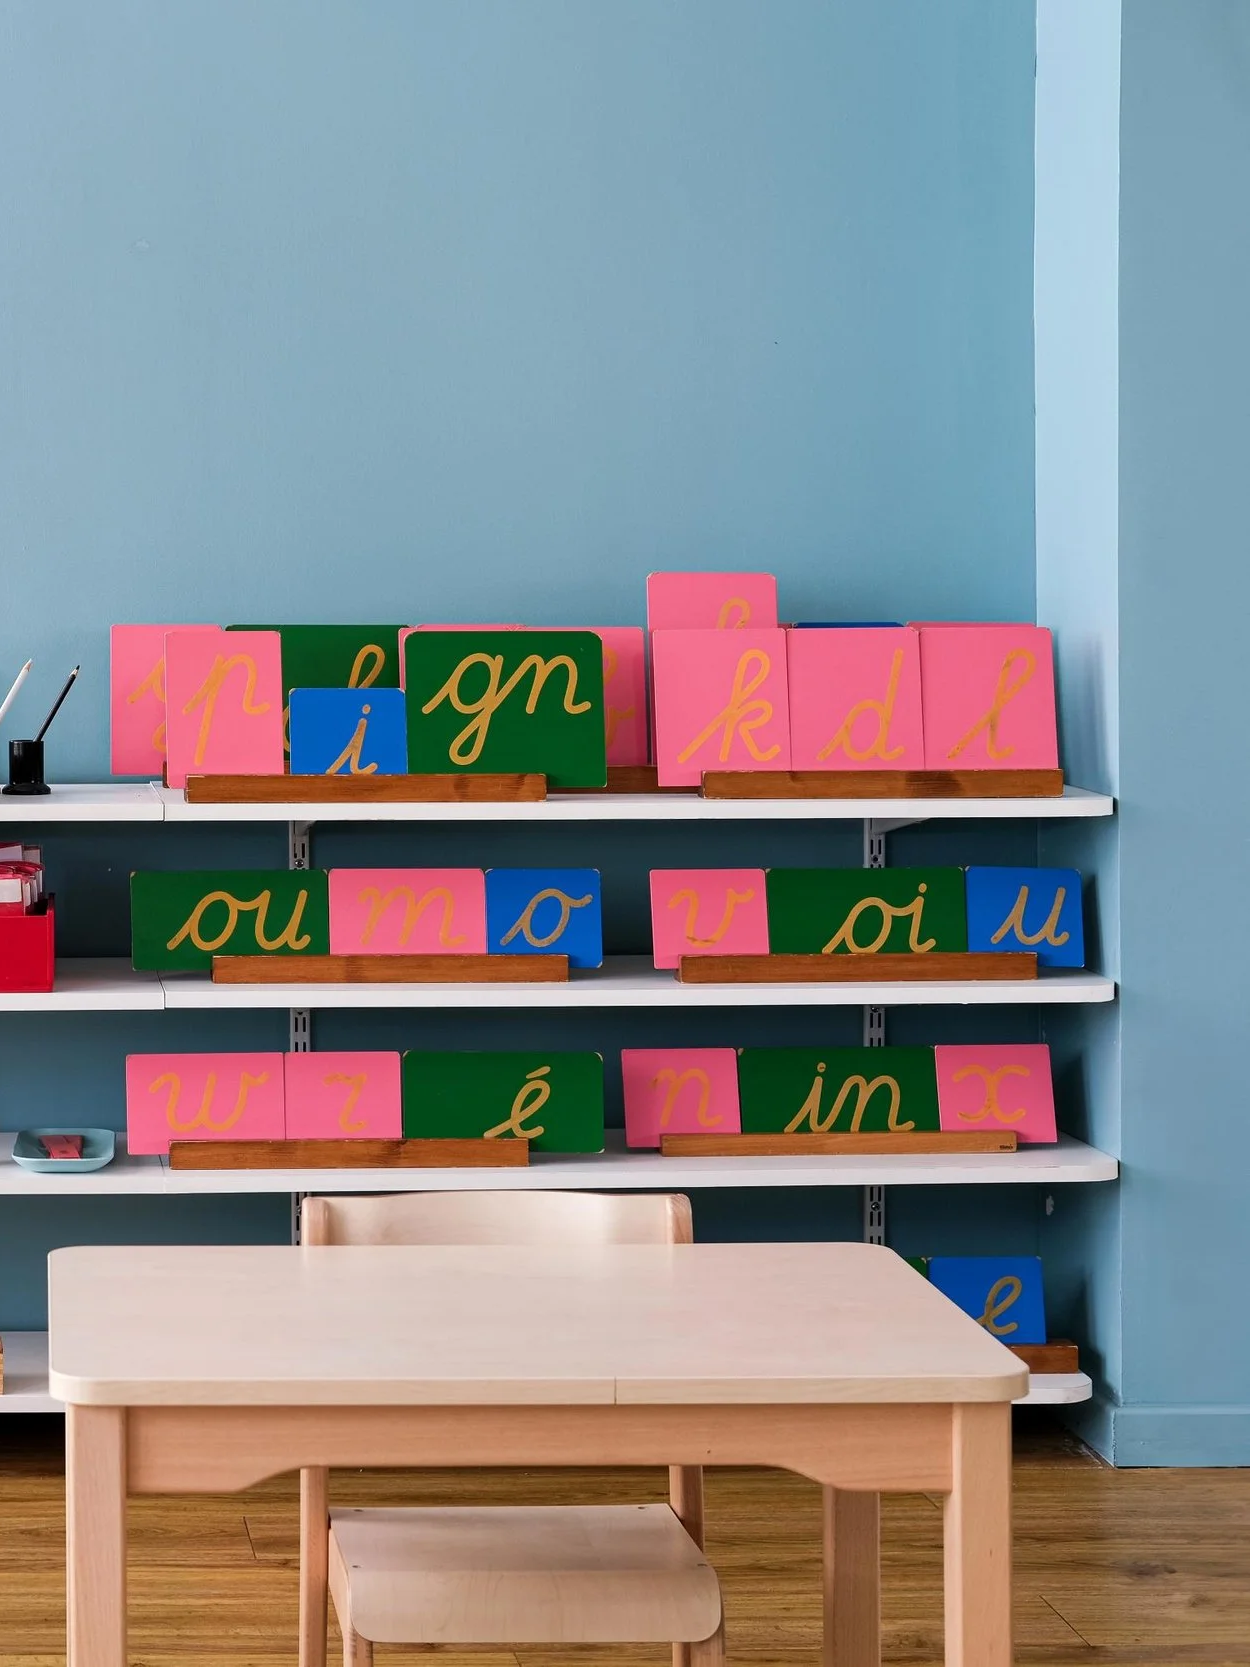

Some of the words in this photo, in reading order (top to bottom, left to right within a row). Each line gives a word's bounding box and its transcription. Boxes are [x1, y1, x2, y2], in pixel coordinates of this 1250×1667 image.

[422, 652, 592, 766] gn
[677, 648, 782, 764] k
[816, 647, 906, 762] d
[947, 647, 1037, 760] l
[325, 704, 378, 775] i
[166, 889, 312, 951] ou
[357, 885, 469, 946] m
[499, 888, 594, 948] o
[667, 888, 756, 948] v
[820, 882, 937, 955] oi
[990, 885, 1070, 946] u
[149, 1071, 271, 1134] w
[483, 1065, 552, 1140] é
[652, 1067, 724, 1128] n
[783, 1061, 917, 1133] in
[951, 1063, 1031, 1124] x
[975, 1275, 1023, 1336] e
